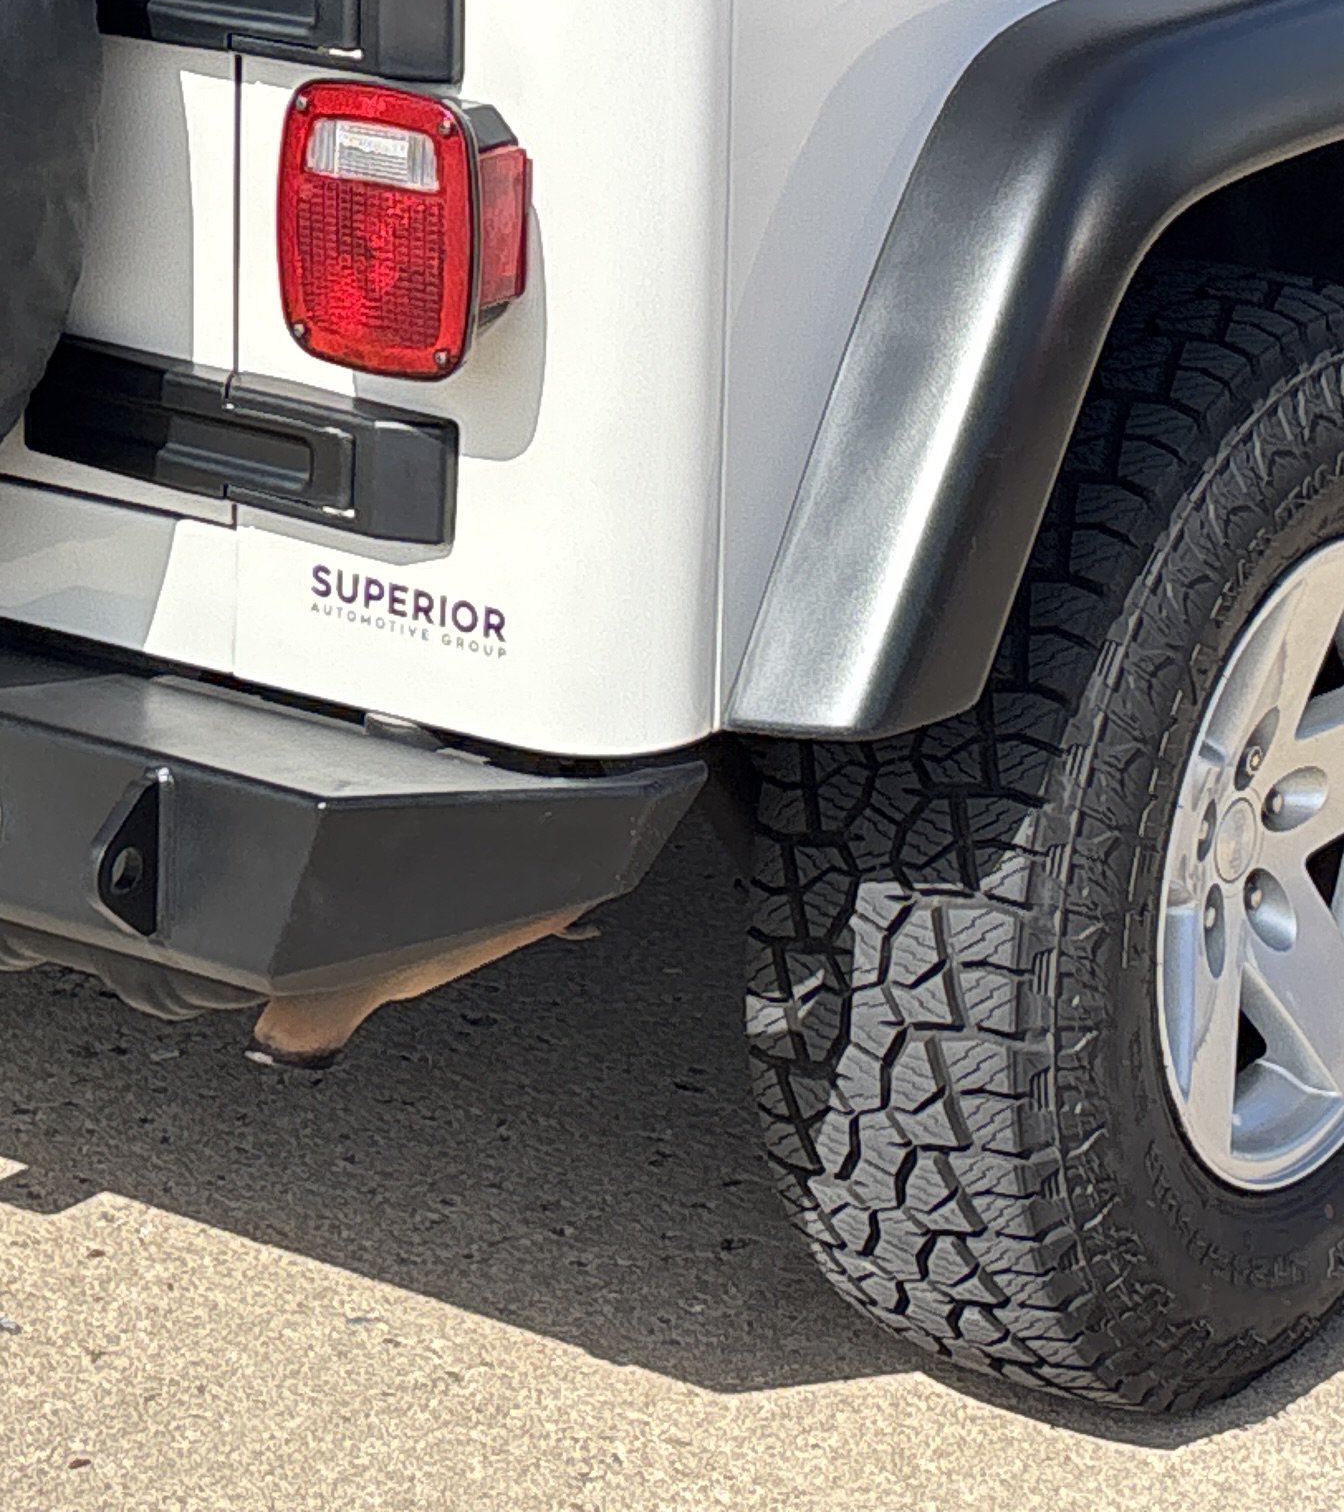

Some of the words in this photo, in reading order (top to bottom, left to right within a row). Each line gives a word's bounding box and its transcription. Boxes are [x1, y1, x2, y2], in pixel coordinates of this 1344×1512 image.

[311, 564, 506, 642] SUPERIOR
[311, 602, 429, 641] AUTOMOTIVE
[441, 633, 507, 659] GROUP
